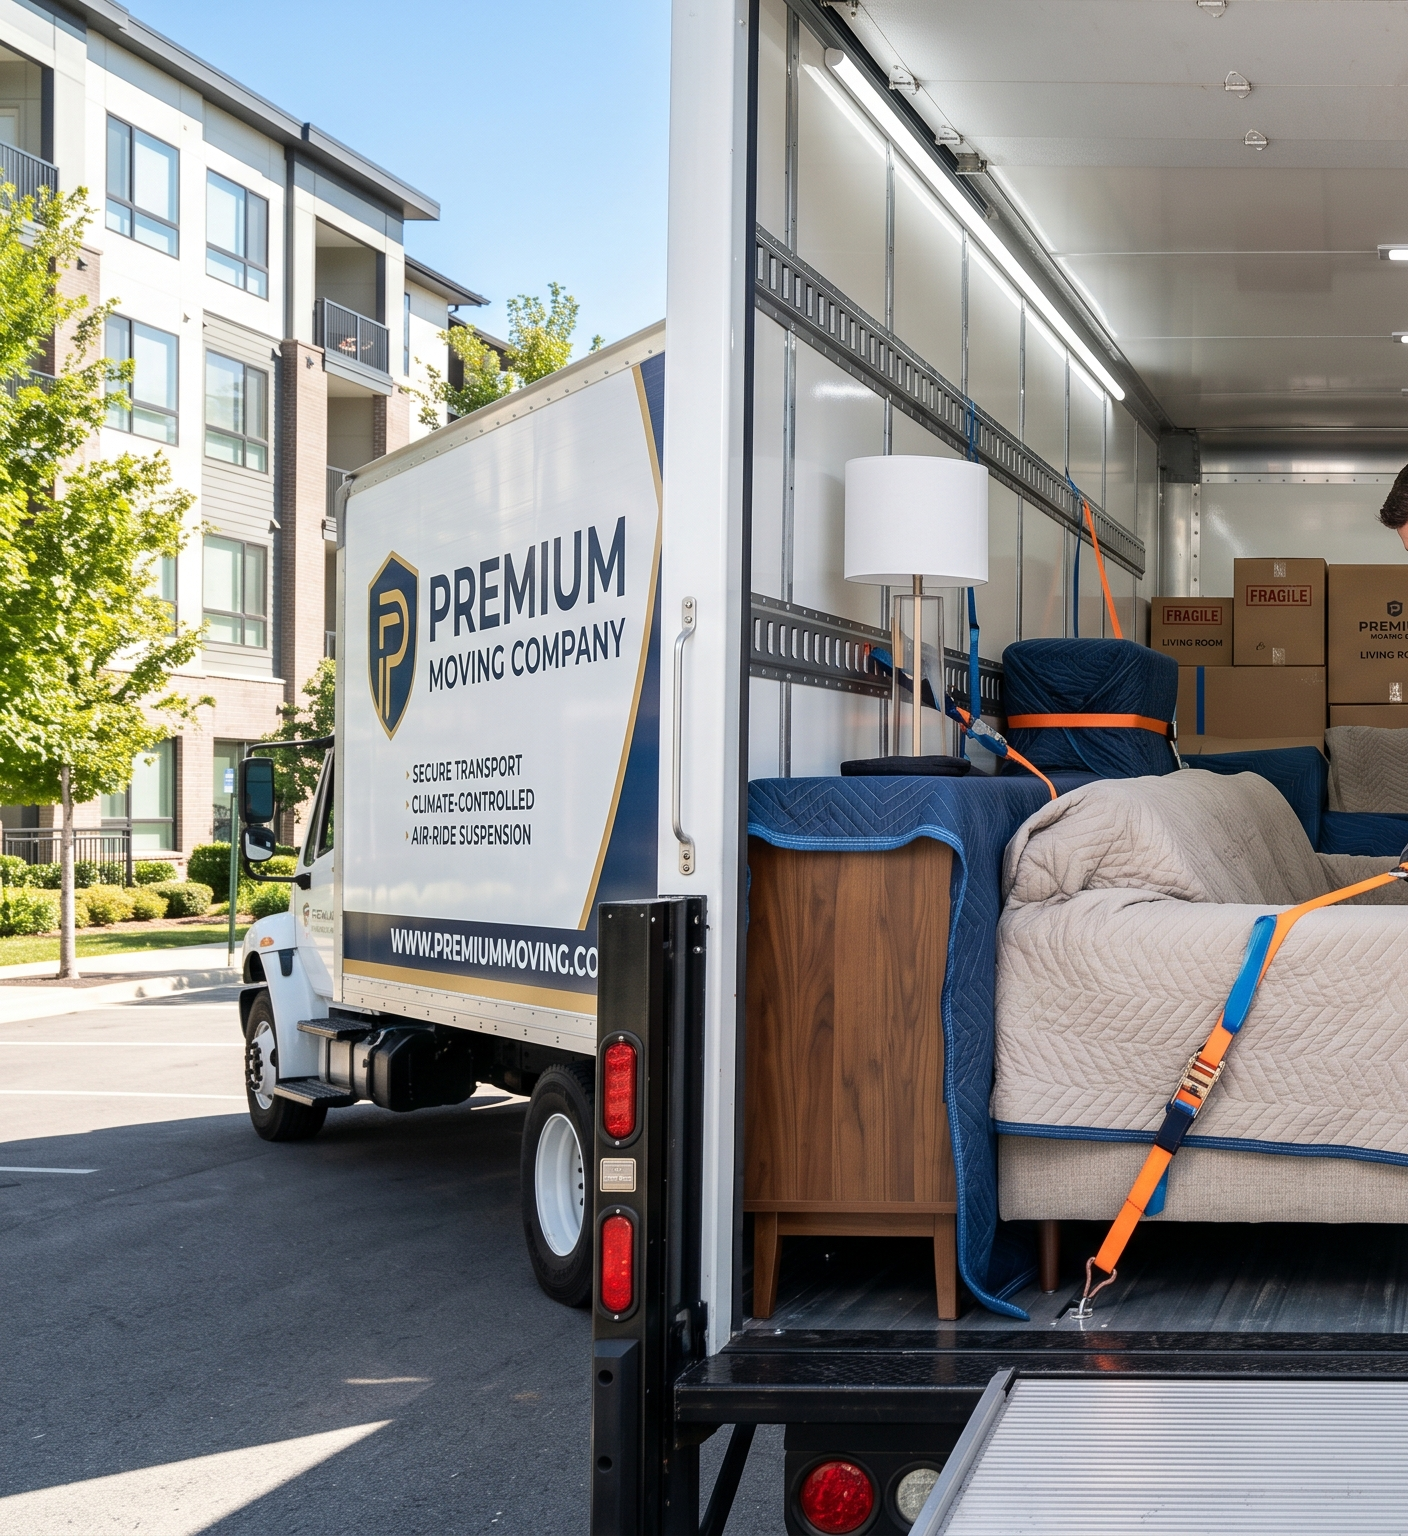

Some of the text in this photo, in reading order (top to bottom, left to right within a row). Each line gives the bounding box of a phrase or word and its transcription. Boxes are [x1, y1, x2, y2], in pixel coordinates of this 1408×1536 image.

[429, 516, 627, 643] PREMIUM
[1250, 588, 1308, 604] FRAGILE
[1166, 609, 1219, 623] FRAGILE
[428, 617, 627, 694] MOVING COMPANY
[1162, 639, 1223, 648] LIVING ROOM
[1360, 651, 1395, 659] LIVING
[412, 754, 522, 784] SECURE TRANSPORT
[411, 788, 535, 815] CLIMATE-CONTROLLED
[410, 823, 532, 846] AIR-RIDE SUSPENSION
[390, 927, 599, 979] WWW.PREMIUMMOVING.CO
